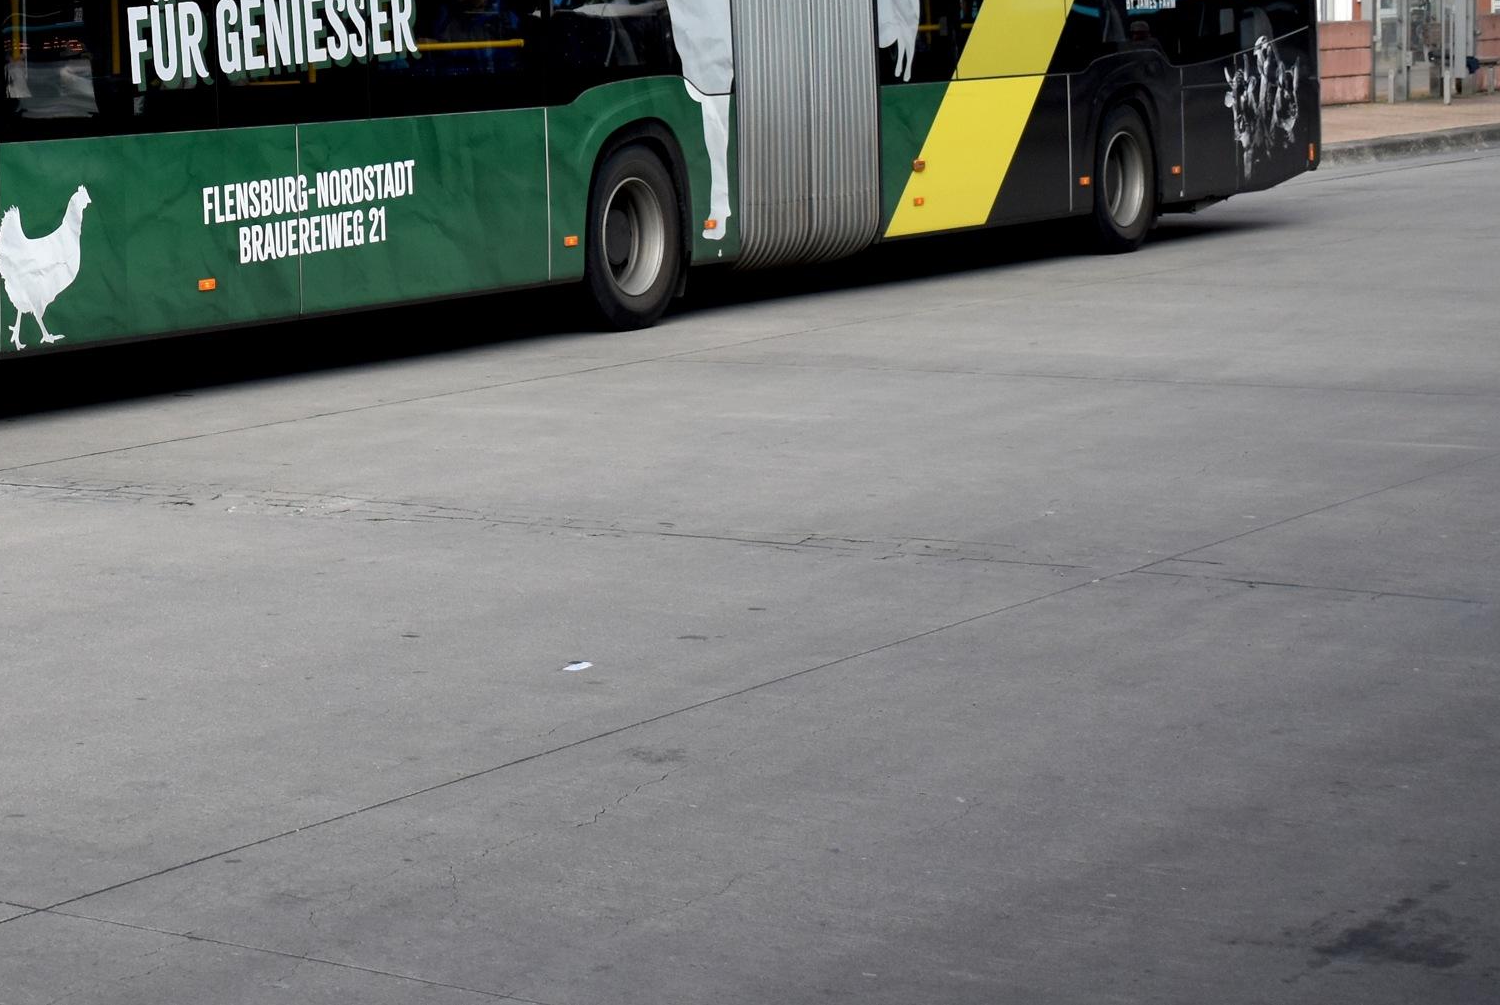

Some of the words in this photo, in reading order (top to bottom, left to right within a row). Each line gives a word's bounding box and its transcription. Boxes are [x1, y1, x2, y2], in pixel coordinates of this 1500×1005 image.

[202, 159, 415, 225] FLENSBURG-NORDSTADT
[238, 209, 365, 264] BRAUEREIWEG
[368, 205, 387, 243] 21
